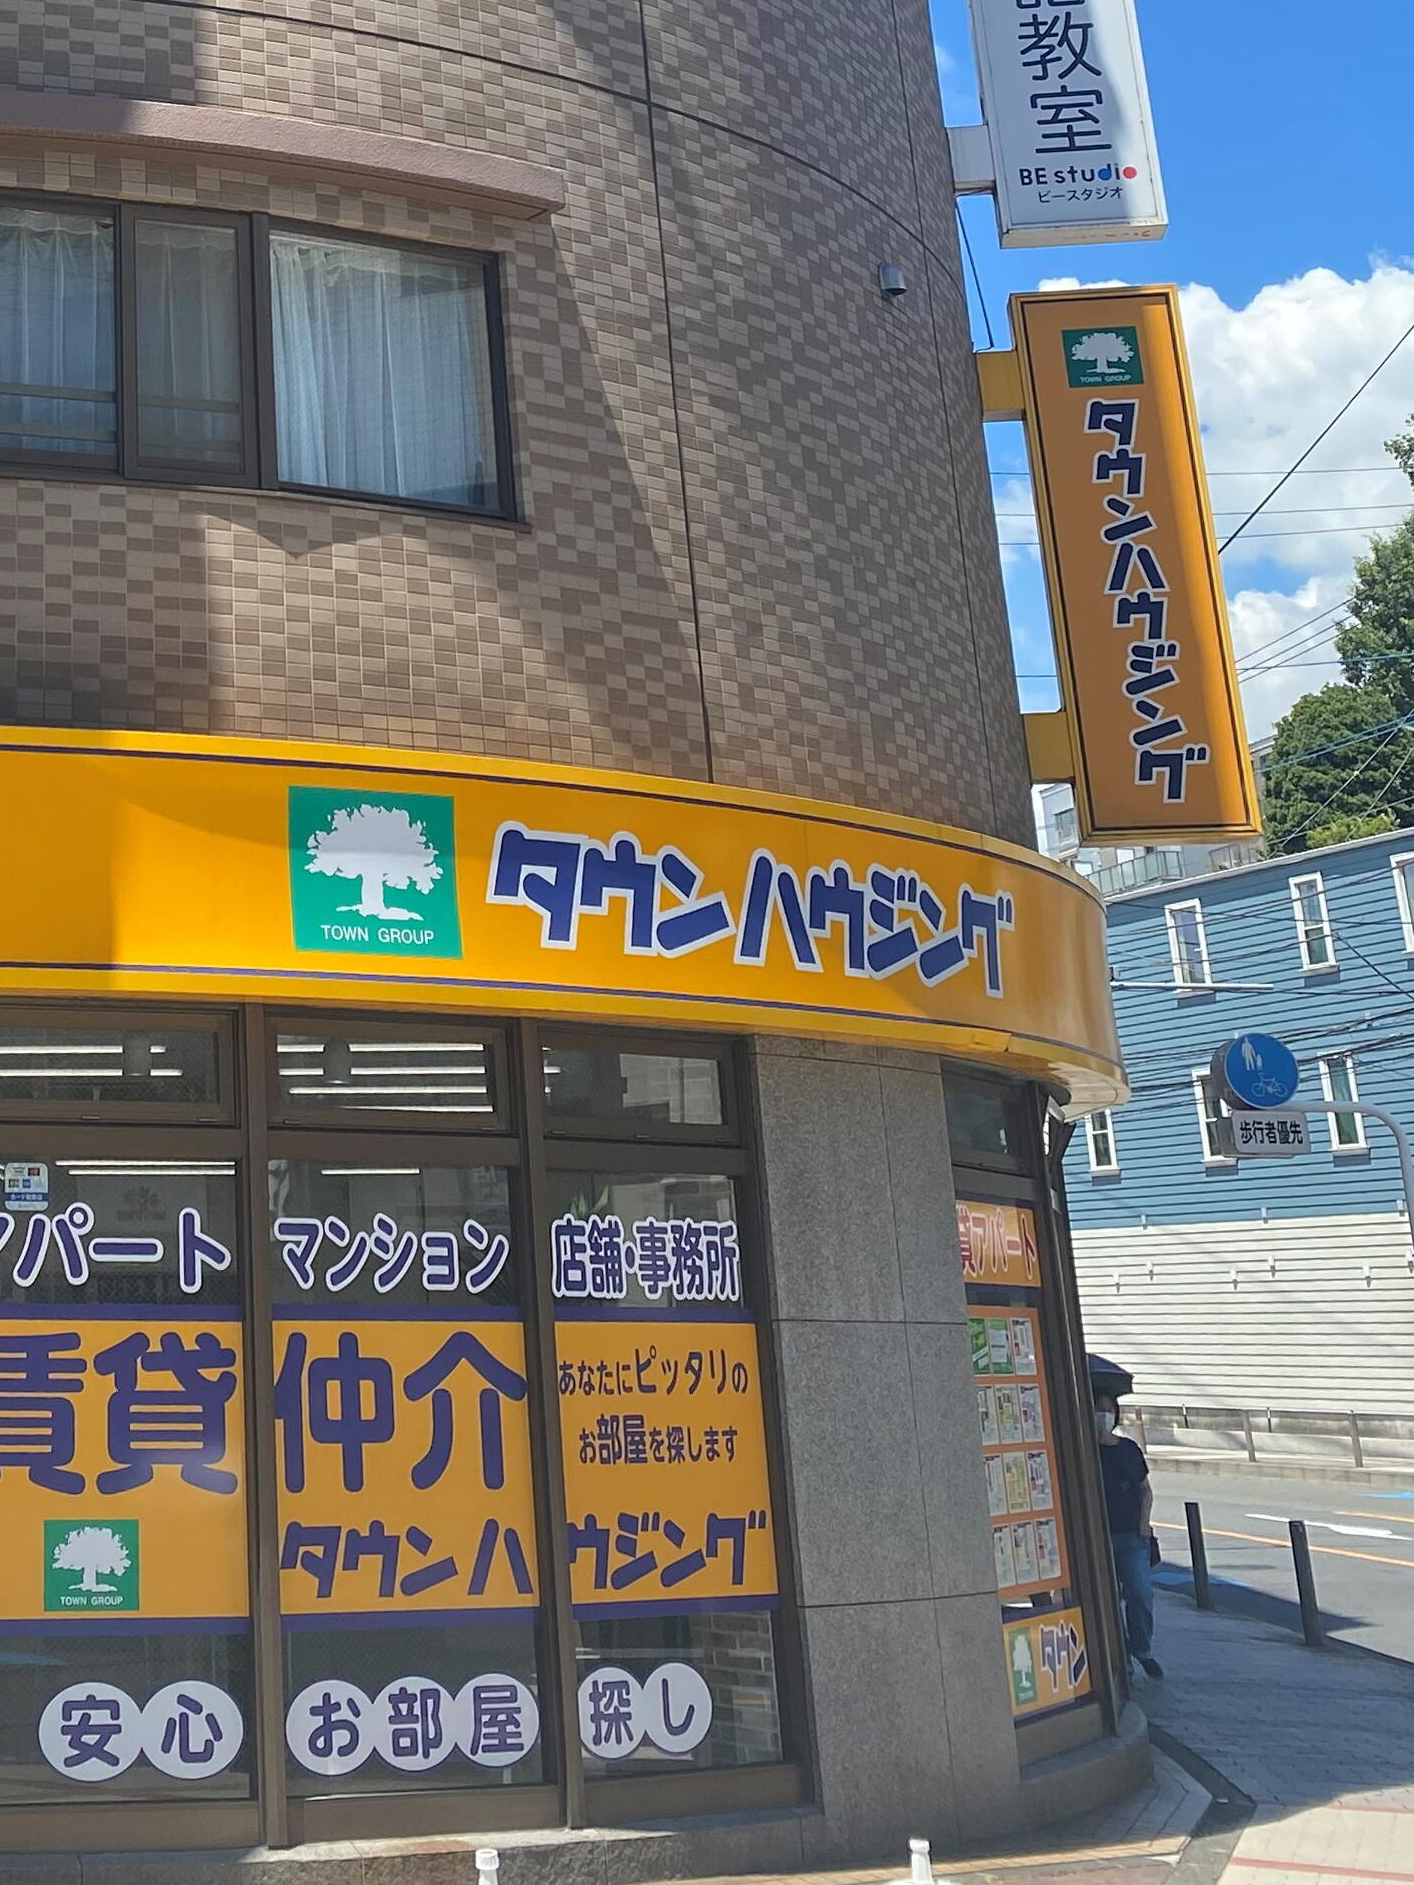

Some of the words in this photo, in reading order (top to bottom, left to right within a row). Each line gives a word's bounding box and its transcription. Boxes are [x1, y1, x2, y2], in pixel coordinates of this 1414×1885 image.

[1019, 167, 1048, 185] BE
[1054, 163, 1137, 184] studio
[1038, 187, 1123, 203] ビースタジオ
[1104, 374, 1132, 382] GROUP
[1083, 397, 1209, 803] タウンハウジング
[321, 923, 369, 942] TOWN
[378, 926, 435, 945] GROUP
[486, 820, 1015, 999] タウンハウジング
[1240, 1121, 1304, 1145] 歩行者優先
[274, 1213, 510, 1294] マンション
[551, 1213, 740, 1302] 店舗・事務所
[559, 1344, 749, 1396] あなたにピッタリの
[274, 1331, 527, 1494] 仲介
[578, 1414, 739, 1466] お部屋を探します
[60, 1596, 87, 1605] TOWN
[91, 1596, 123, 1605] GROUP
[1038, 1619, 1088, 1692] タウン
[60, 1693, 223, 1768] 安心
